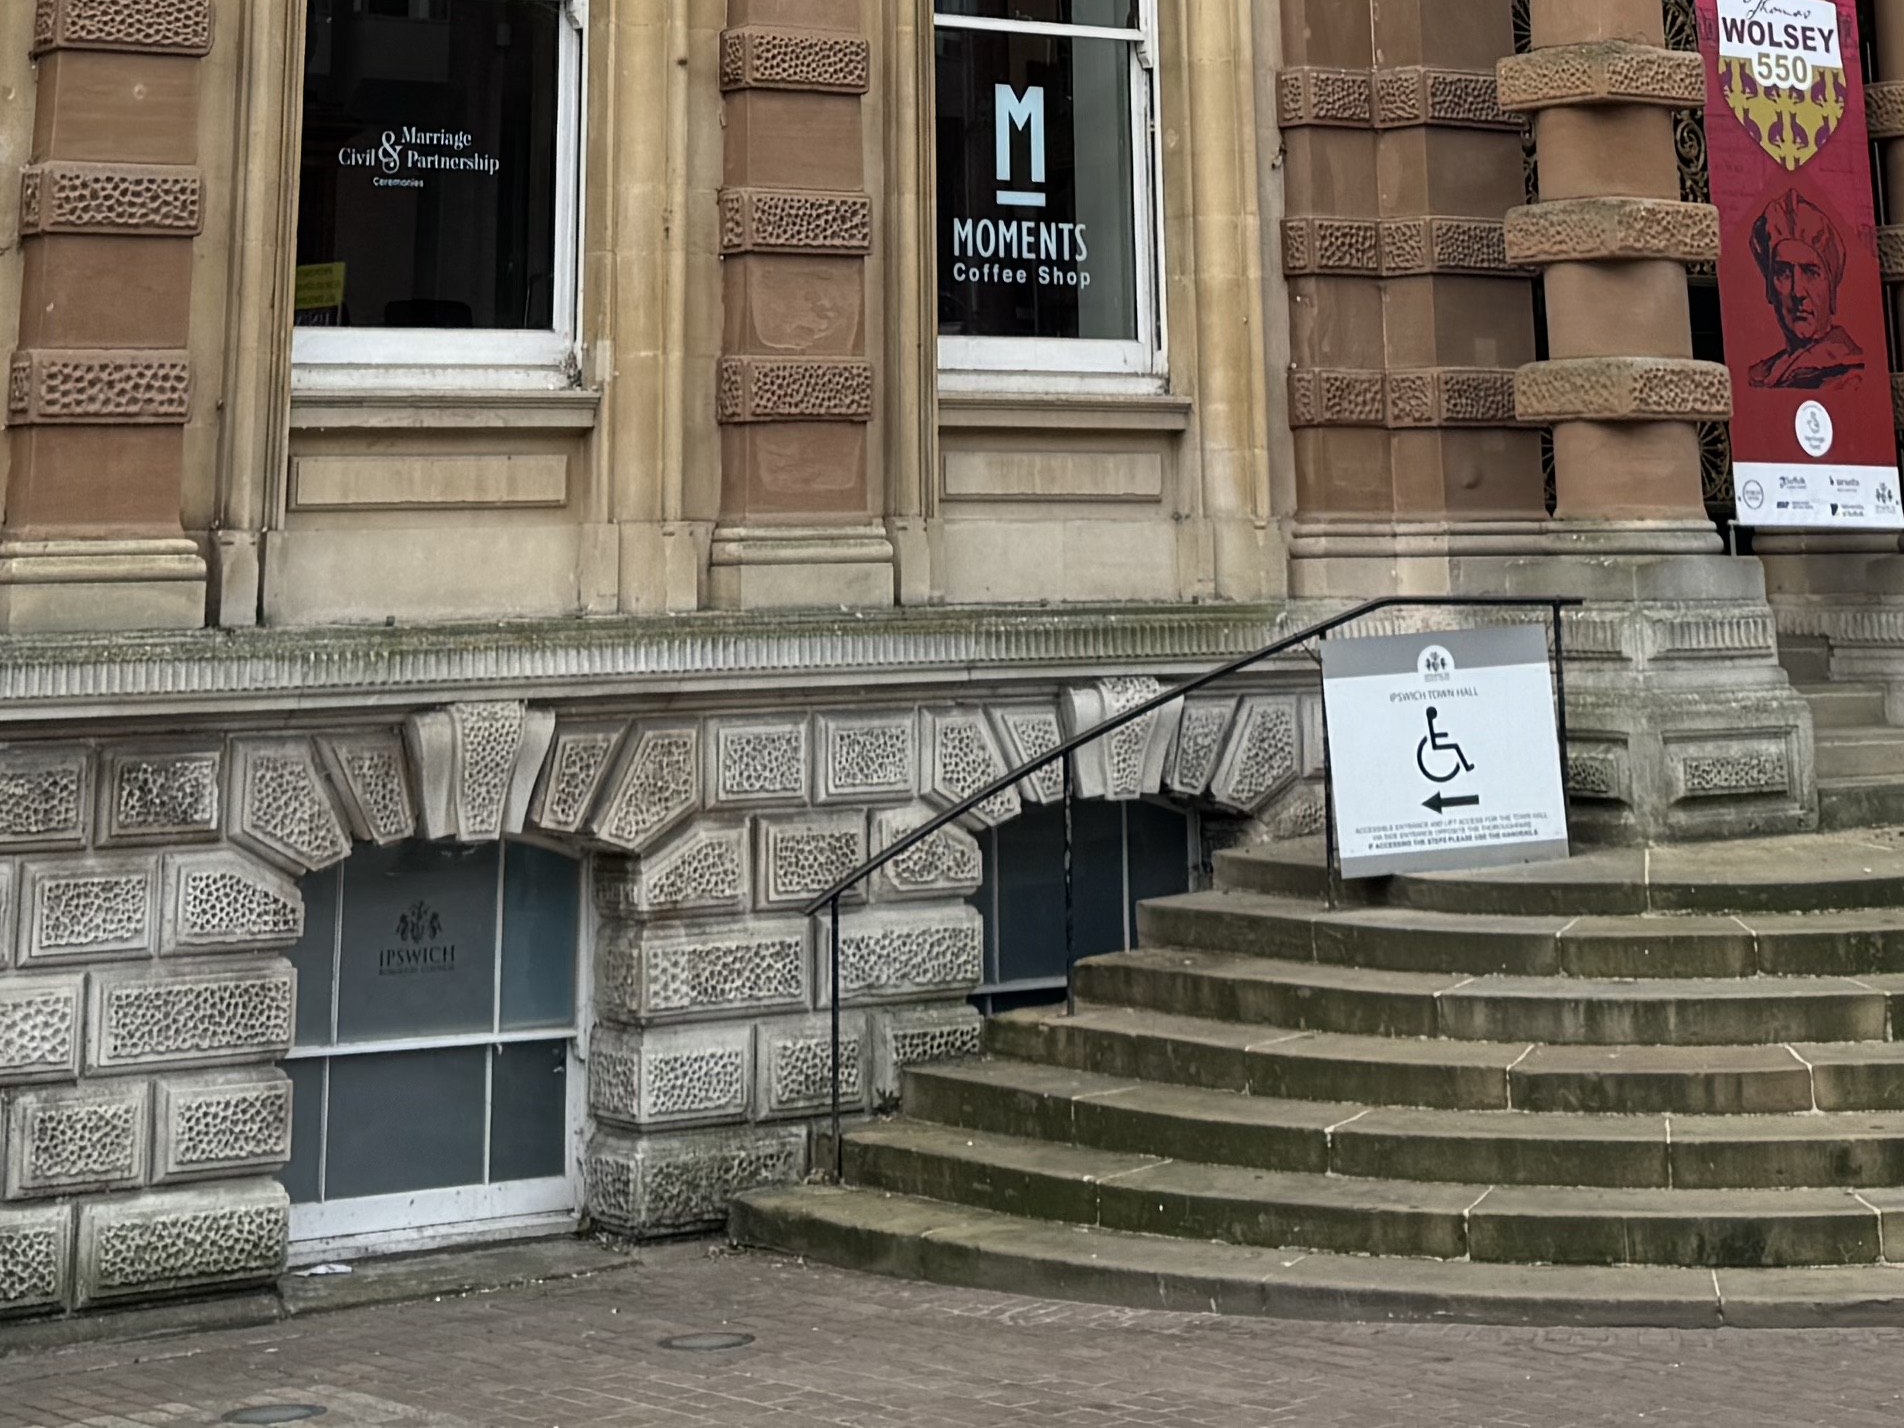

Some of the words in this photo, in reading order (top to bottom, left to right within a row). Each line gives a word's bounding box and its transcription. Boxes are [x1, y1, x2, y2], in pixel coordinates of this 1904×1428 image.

[1721, 16, 1834, 54] WOLSEY
[1757, 52, 1808, 84] 550
[338, 147, 376, 166] Civil
[378, 130, 404, 174] &
[407, 150, 500, 175] Partnership
[400, 126, 472, 151] Marriage
[372, 176, 424, 187] Ceremonies
[953, 217, 1088, 262] MOMENTS
[953, 261, 1027, 284] Coffee
[1038, 265, 1091, 289] Shop
[380, 945, 455, 967] IPSWICH
